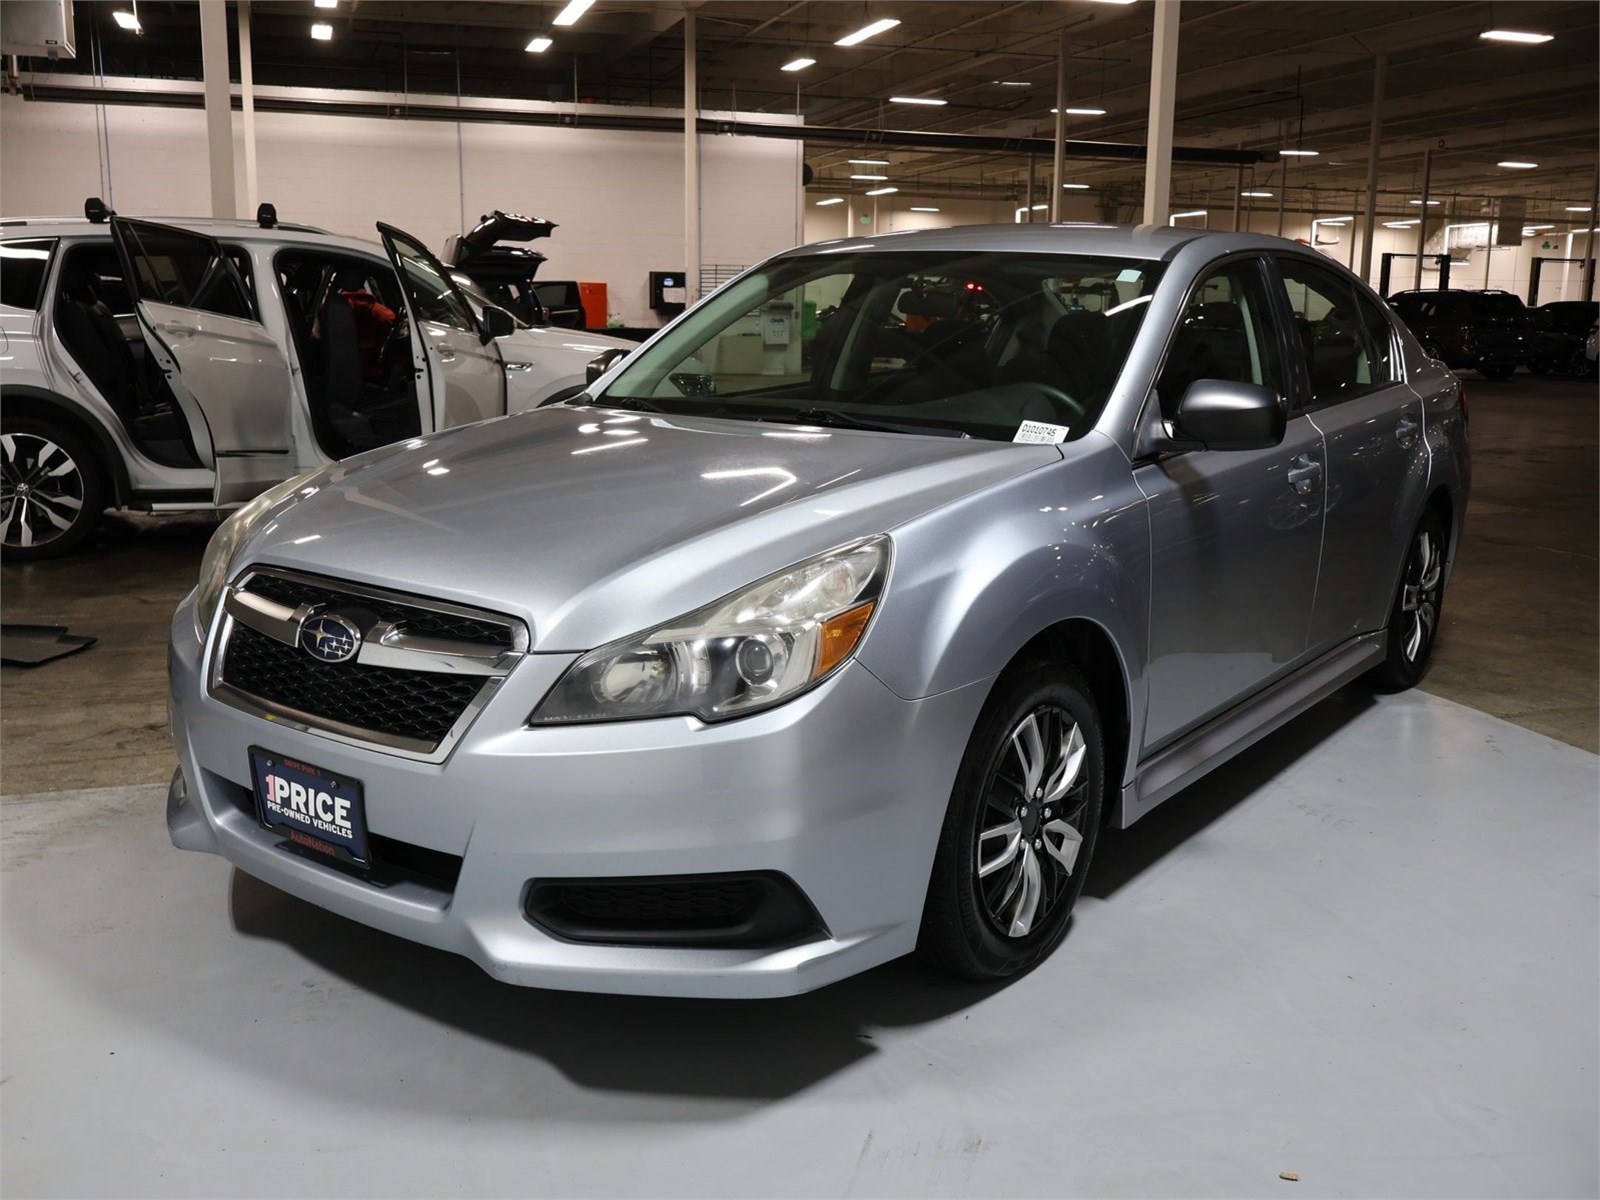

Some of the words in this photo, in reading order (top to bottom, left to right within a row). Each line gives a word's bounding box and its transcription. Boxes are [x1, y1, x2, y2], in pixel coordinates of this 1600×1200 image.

[267, 801, 311, 825] PRE-OWNED
[313, 818, 353, 839] VEHICLES
[290, 831, 336, 856] AutoNation
